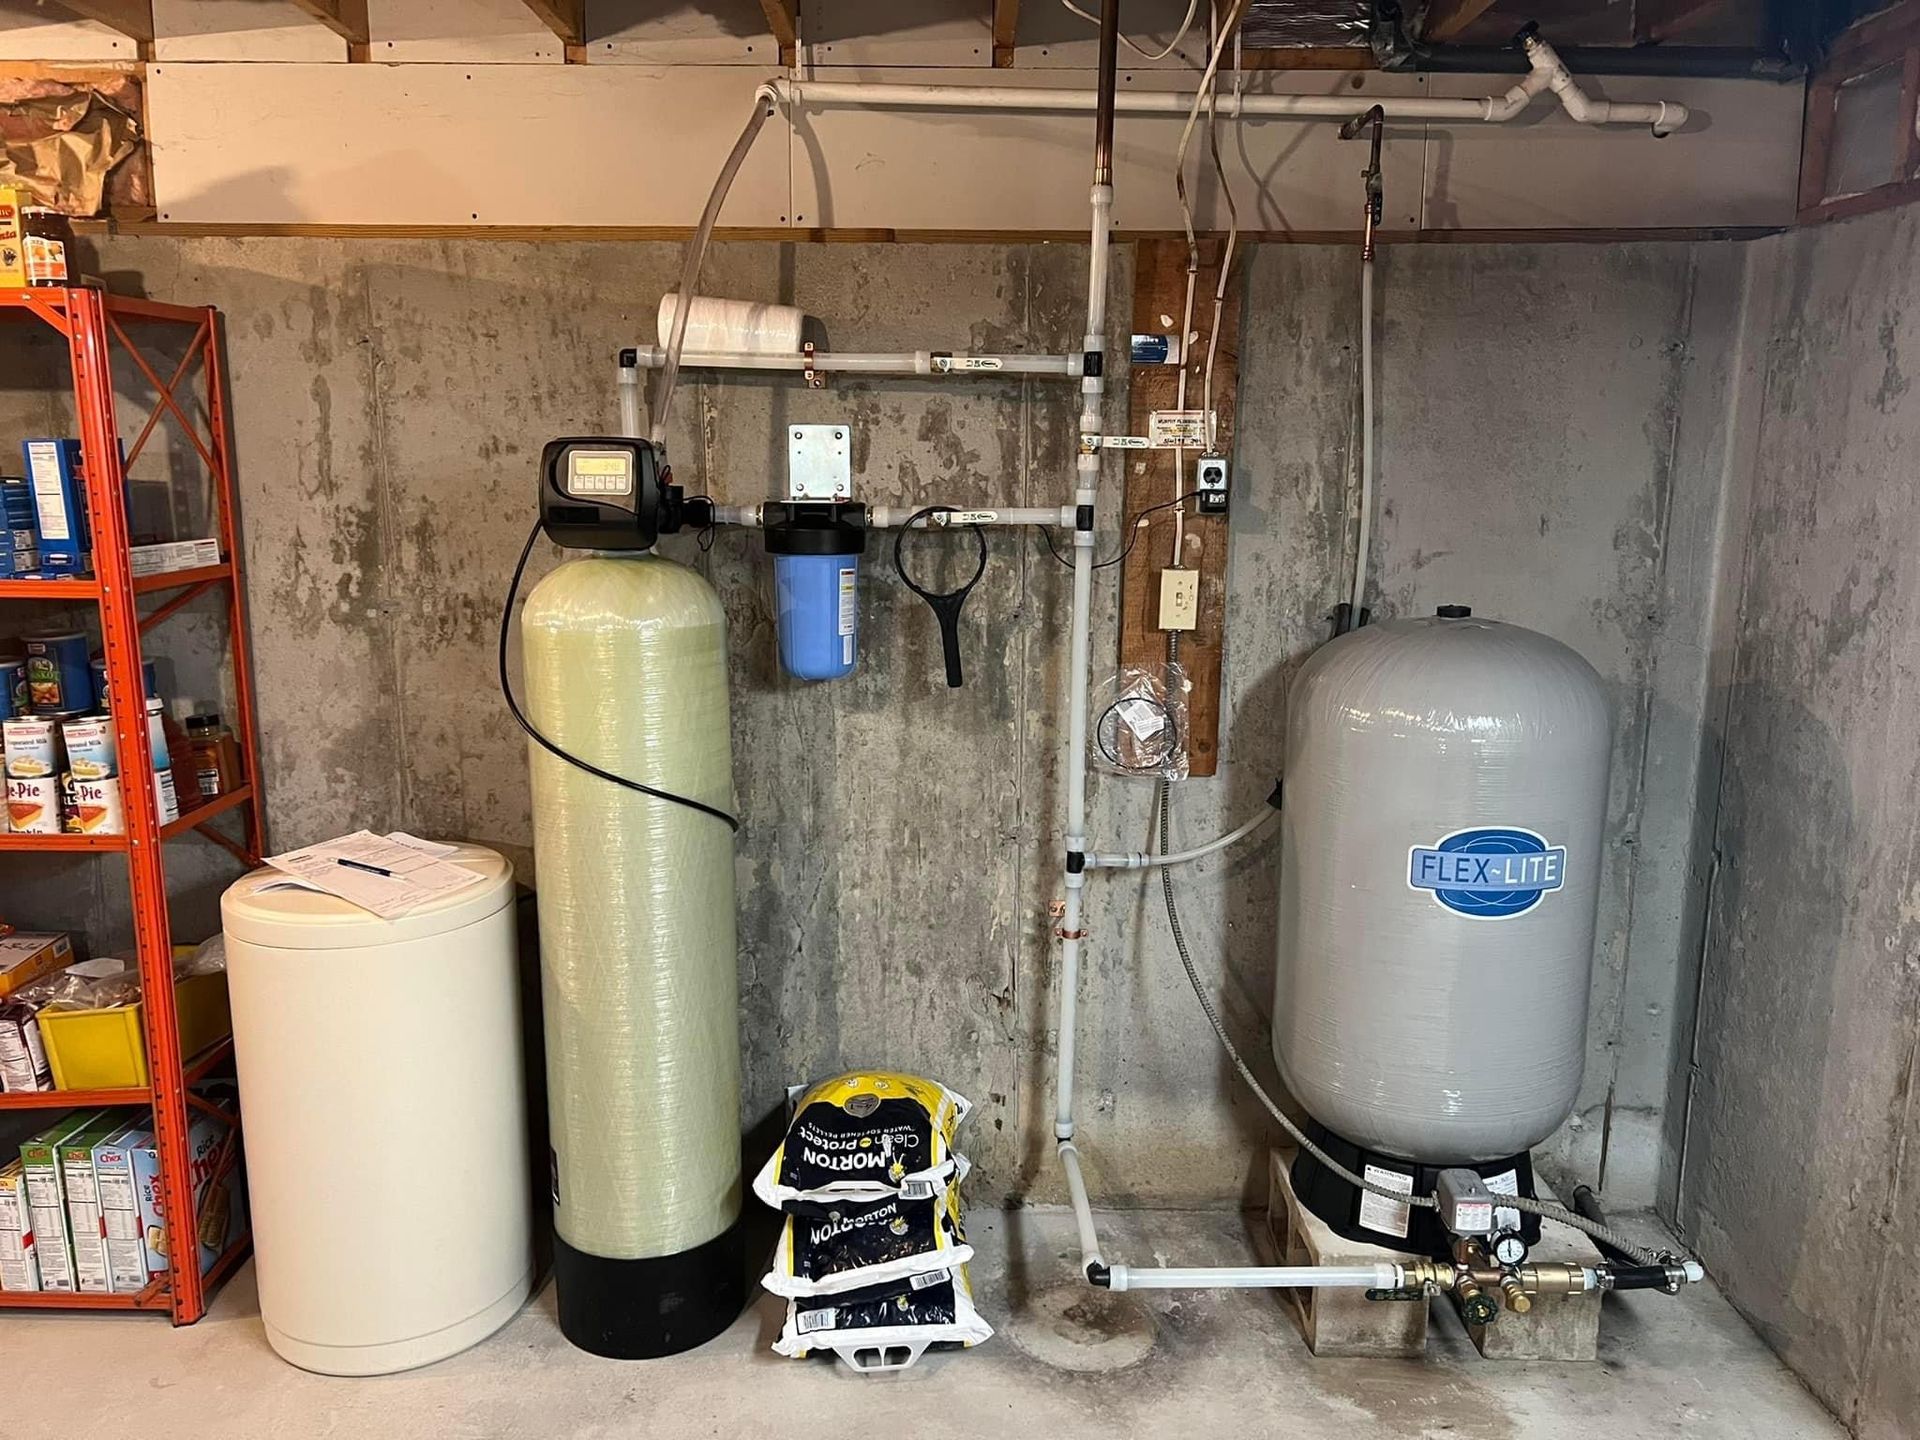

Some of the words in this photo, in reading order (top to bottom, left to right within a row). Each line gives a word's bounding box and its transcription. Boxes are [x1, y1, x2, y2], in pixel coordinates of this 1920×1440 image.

[808, 1122, 838, 1139] PELLETS
[841, 1128, 881, 1139] SOFTENER
[883, 1125, 912, 1134] WATER
[874, 1134, 920, 1148] Clean
[100, 1153, 122, 1163] Chex
[803, 1146, 886, 1171] MORTON
[144, 1185, 152, 1202] Rice
